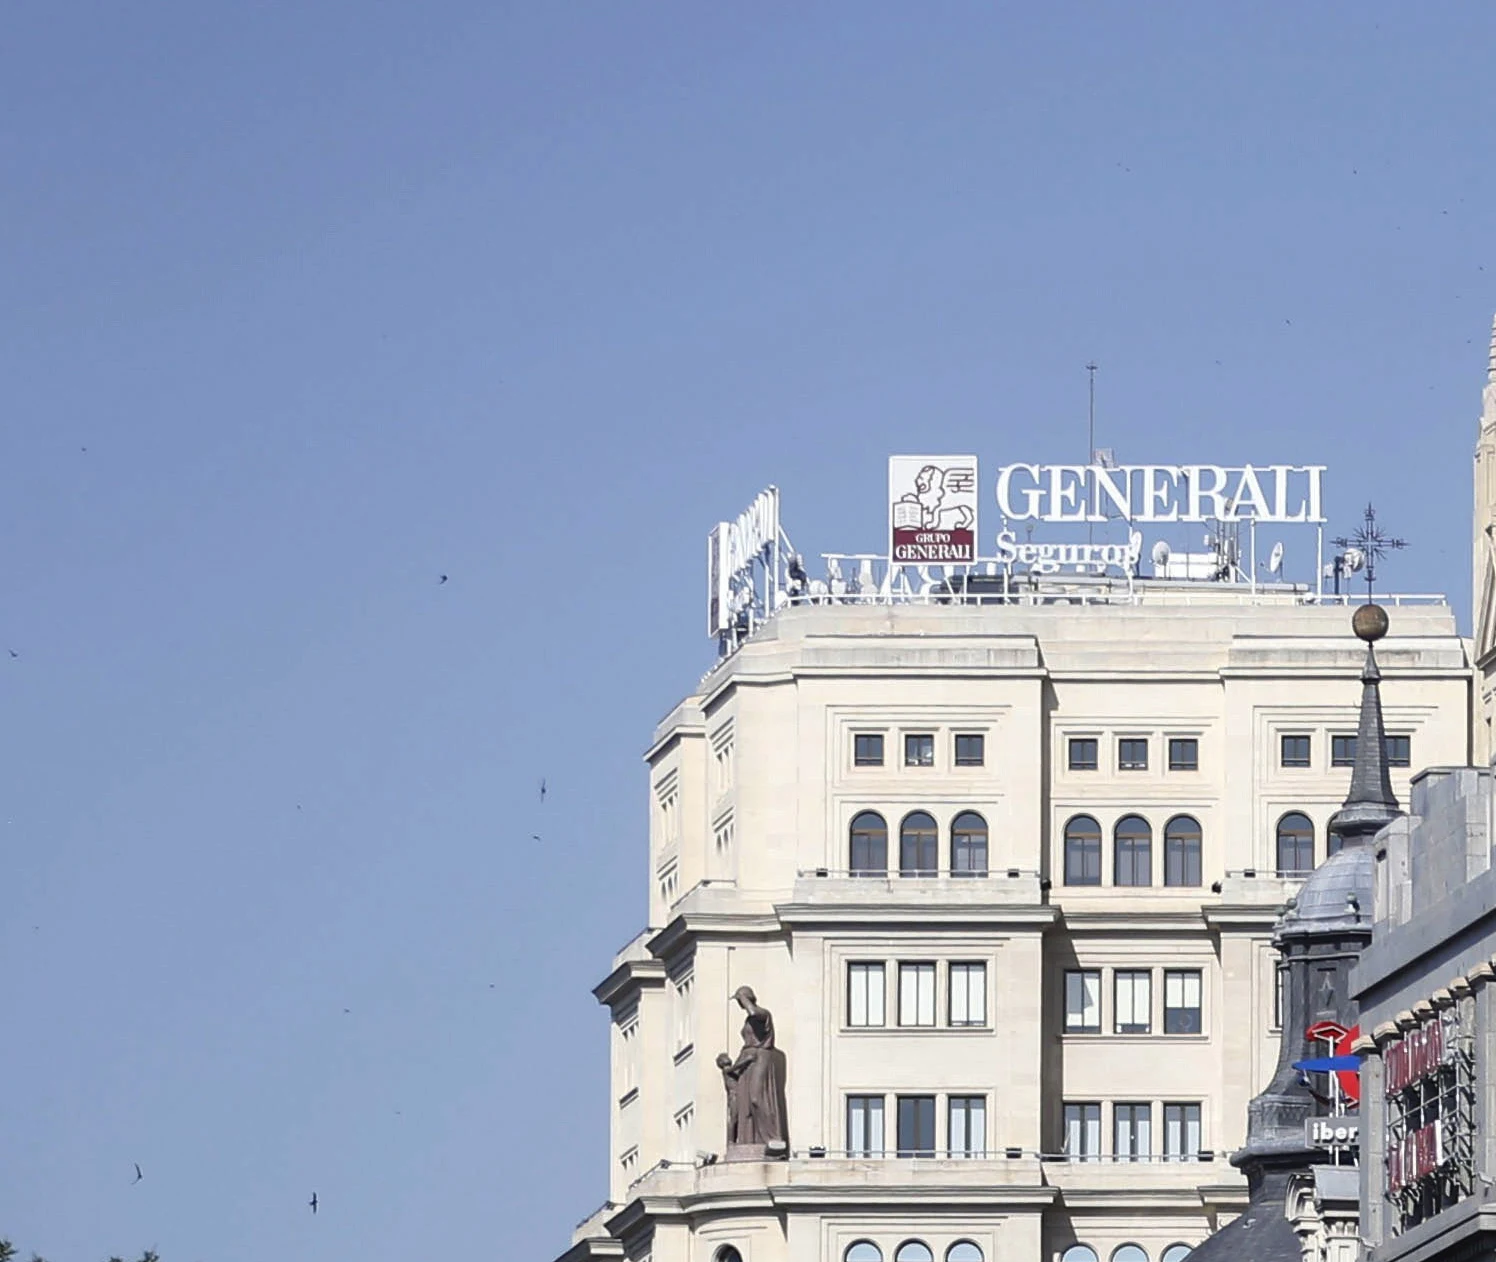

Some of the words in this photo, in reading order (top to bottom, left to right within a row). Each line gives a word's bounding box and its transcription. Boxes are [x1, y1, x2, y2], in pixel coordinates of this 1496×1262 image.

[996, 462, 1328, 523] GENERALI
[915, 533, 951, 543] GRUPO
[895, 544, 971, 560] GENERALI
[996, 530, 1140, 573] Seguros
[1312, 1121, 1358, 1141] iber
